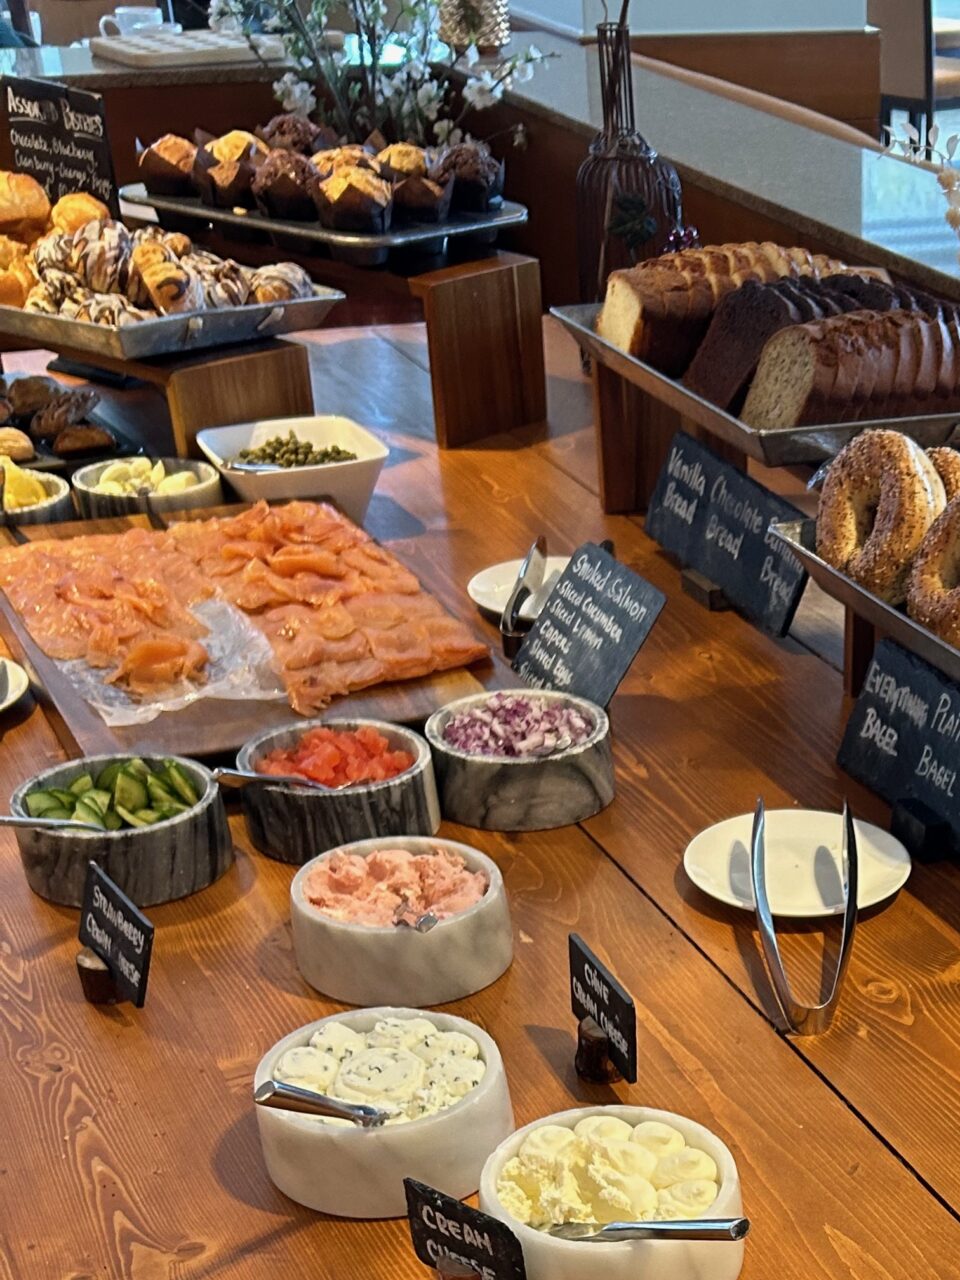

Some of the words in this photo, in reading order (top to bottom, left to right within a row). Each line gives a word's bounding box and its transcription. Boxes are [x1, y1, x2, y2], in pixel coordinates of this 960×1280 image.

[667, 447, 706, 497] Vanilla
[662, 483, 700, 526] Bread
[709, 474, 763, 535] Chocolate
[705, 514, 744, 561] Bread
[572, 554, 612, 592] Smoked
[607, 578, 647, 623] Salmon
[859, 706, 898, 757] BAGEL
[914, 744, 958, 798] BAGEL
[421, 1204, 494, 1256] CREAM
